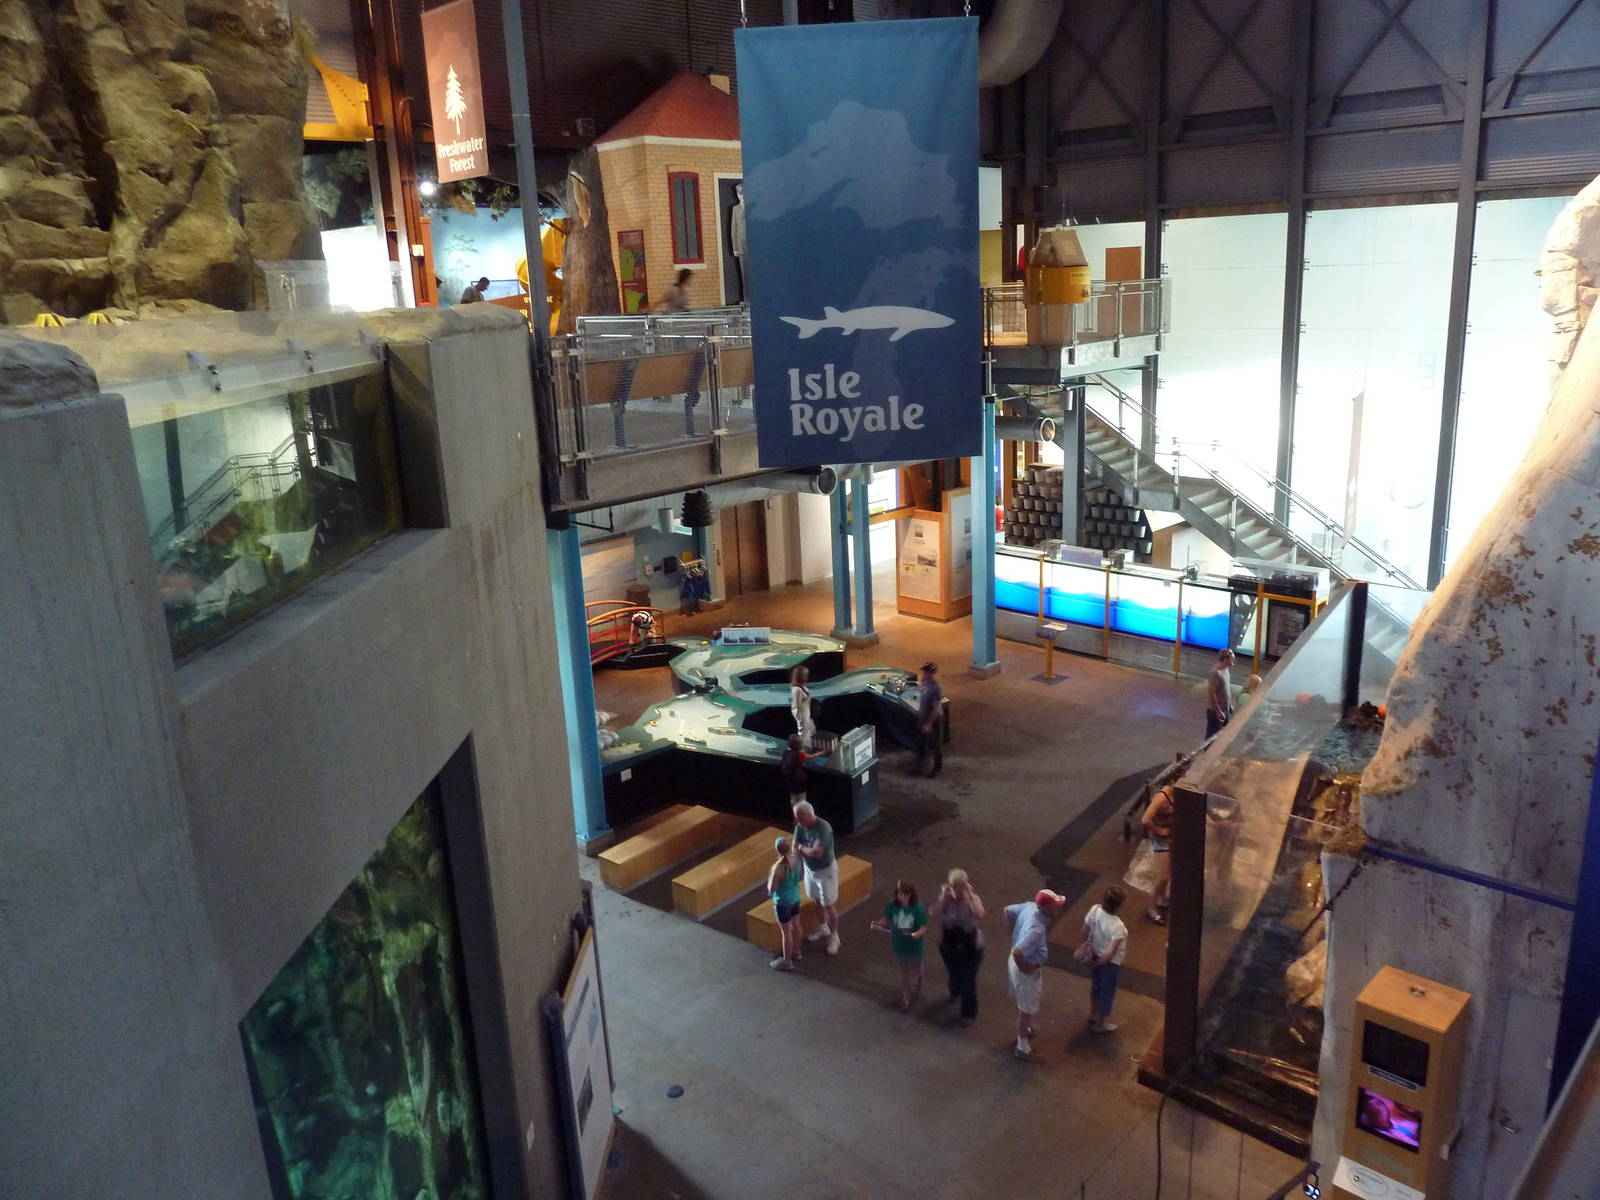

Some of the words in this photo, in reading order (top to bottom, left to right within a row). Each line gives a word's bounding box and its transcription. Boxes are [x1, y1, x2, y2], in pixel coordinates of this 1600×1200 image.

[438, 137, 484, 158] Freshwater
[449, 154, 476, 173] Forest
[788, 363, 862, 401] Isle
[790, 395, 925, 442] Royale
